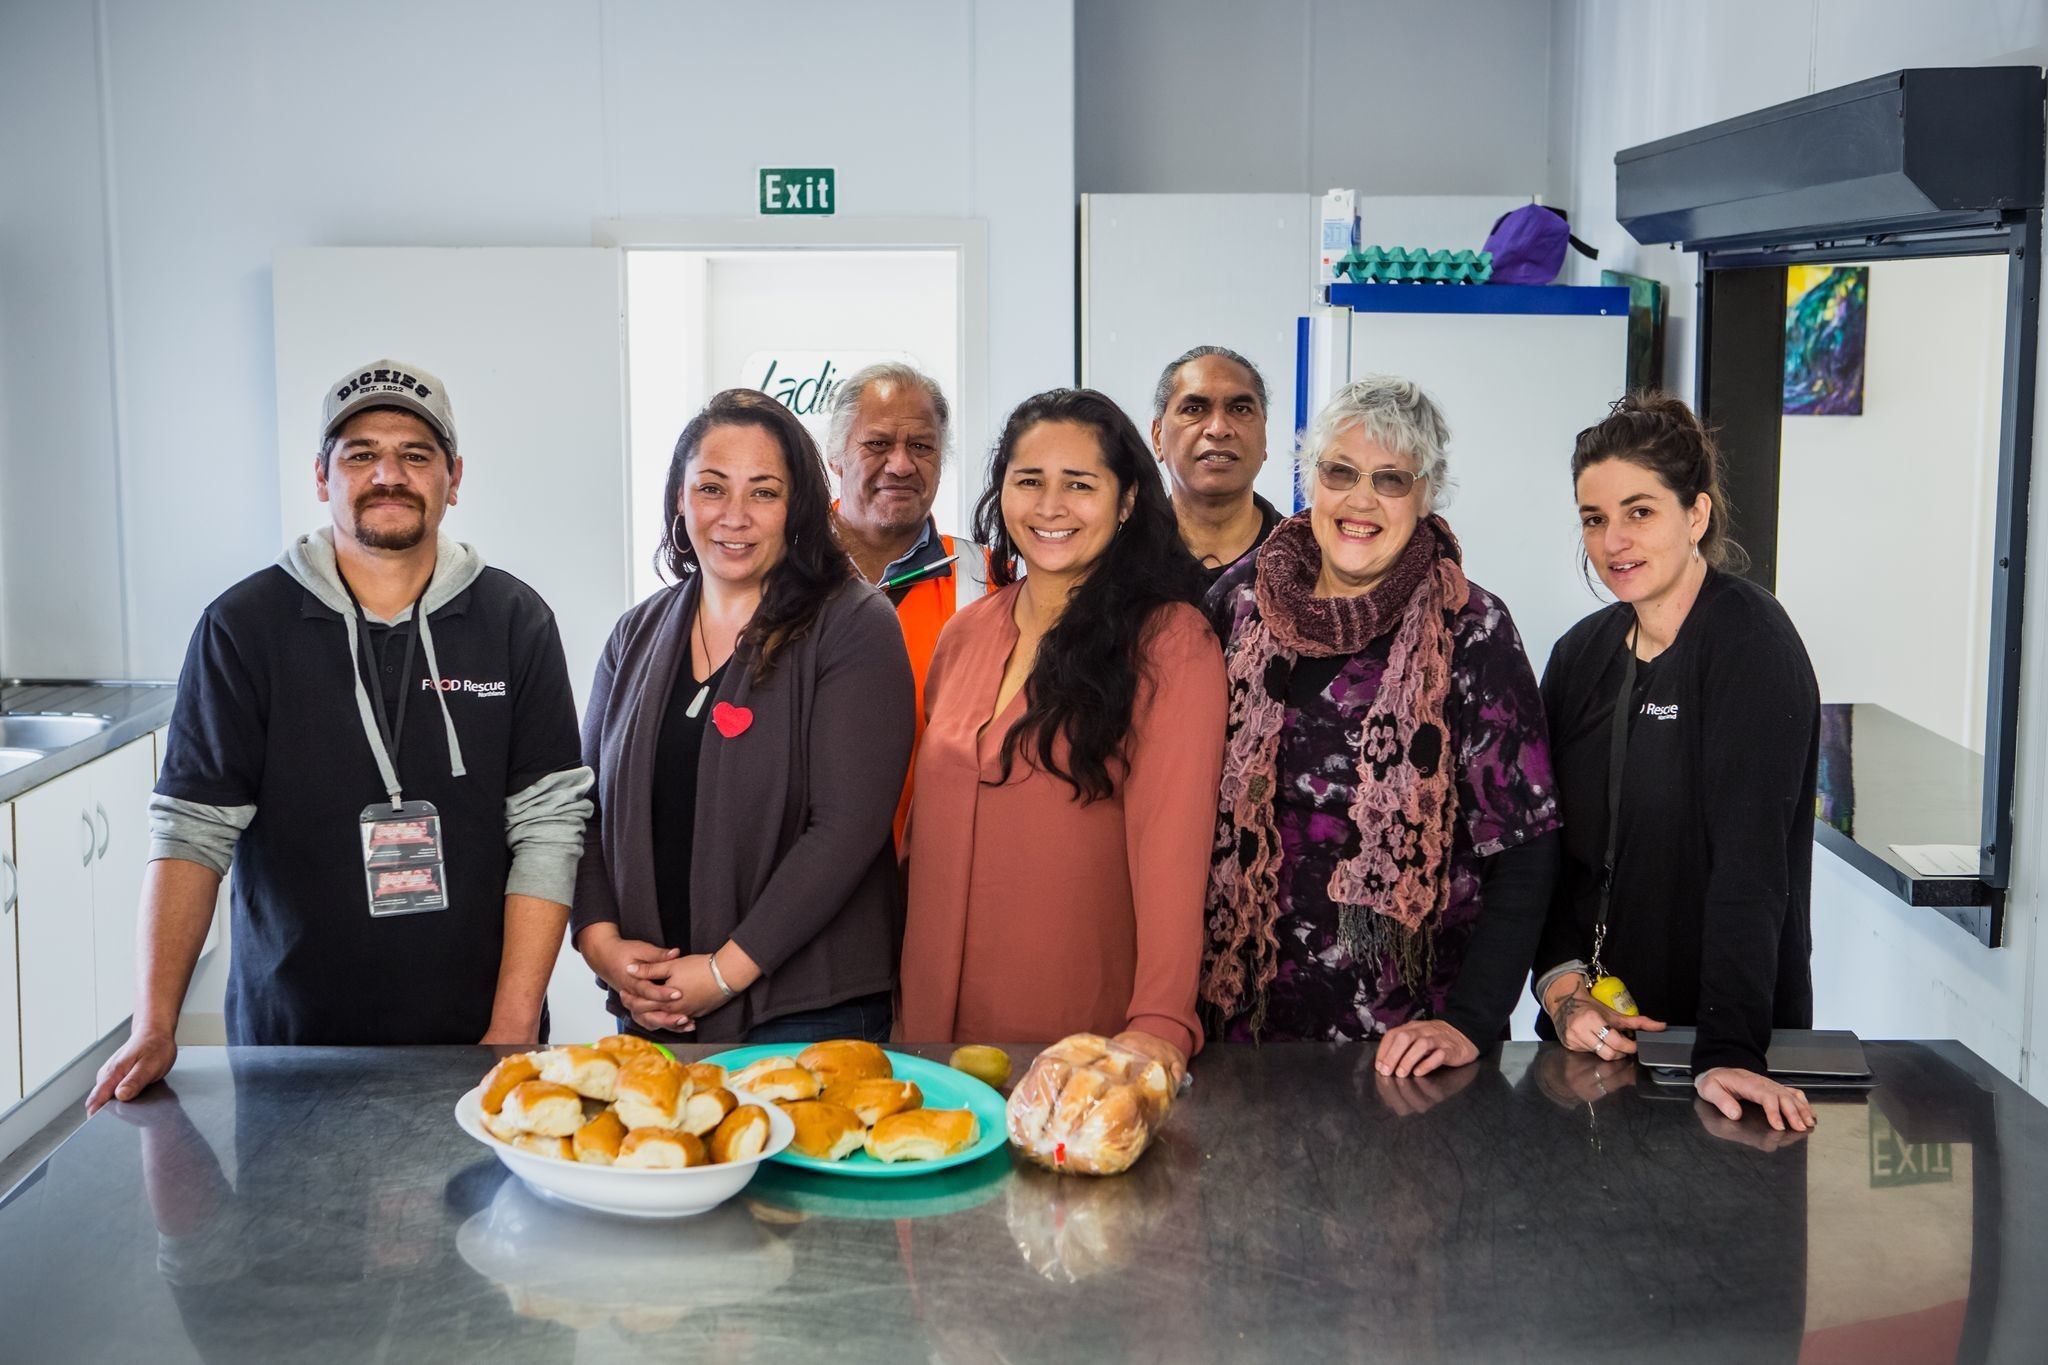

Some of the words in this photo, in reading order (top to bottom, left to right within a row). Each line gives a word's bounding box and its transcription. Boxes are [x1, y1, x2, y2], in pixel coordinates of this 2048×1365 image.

[766, 174, 829, 209] Exit
[337, 369, 432, 401] DICKIES
[360, 385, 379, 394] EST.
[463, 679, 506, 692] Rescue
